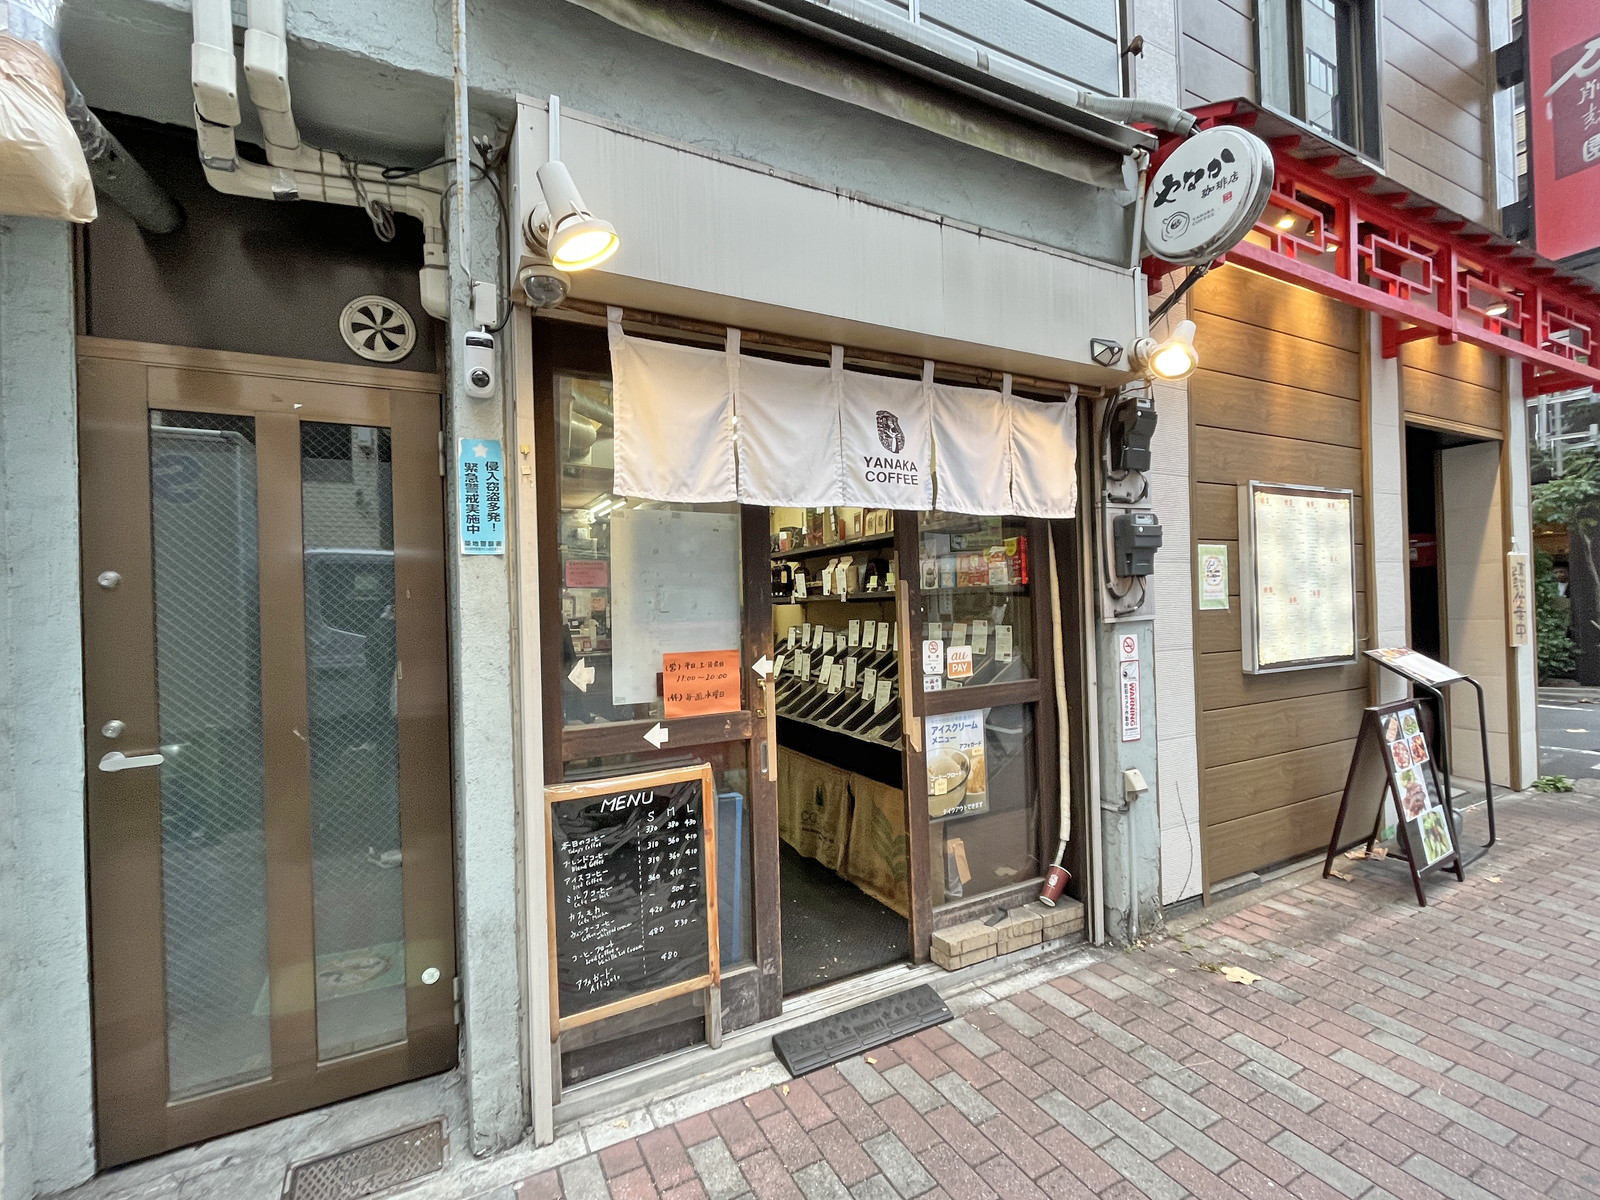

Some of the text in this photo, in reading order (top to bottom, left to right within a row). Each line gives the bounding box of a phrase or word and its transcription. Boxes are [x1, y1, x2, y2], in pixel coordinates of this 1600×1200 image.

[1200, 171, 1239, 199] 珈琲店
[863, 456, 918, 472] YANAKA
[865, 470, 919, 485] COFFEE
[464, 462, 480, 534] 緊急警戒実施中
[951, 651, 969, 661] au
[952, 663, 968, 673] PAY
[931, 720, 978, 735] アイスクリーム
[932, 736, 957, 745] メニュー
[600, 791, 654, 813] MENU
[647, 803, 694, 822] S M L
[646, 825, 658, 834] 330
[667, 820, 679, 829] 380
[647, 841, 659, 850] 310
[667, 836, 680, 845] 360
[684, 833, 697, 841] 410
[564, 848, 698, 886] アイスコーヒー 310 360 410
[566, 868, 683, 904] ミルクコーヒー 360 410
[671, 884, 685, 893] 500
[649, 906, 663, 916] 420
[670, 899, 686, 909] 470
[649, 925, 665, 937] 480
[661, 951, 678, 962] 480
